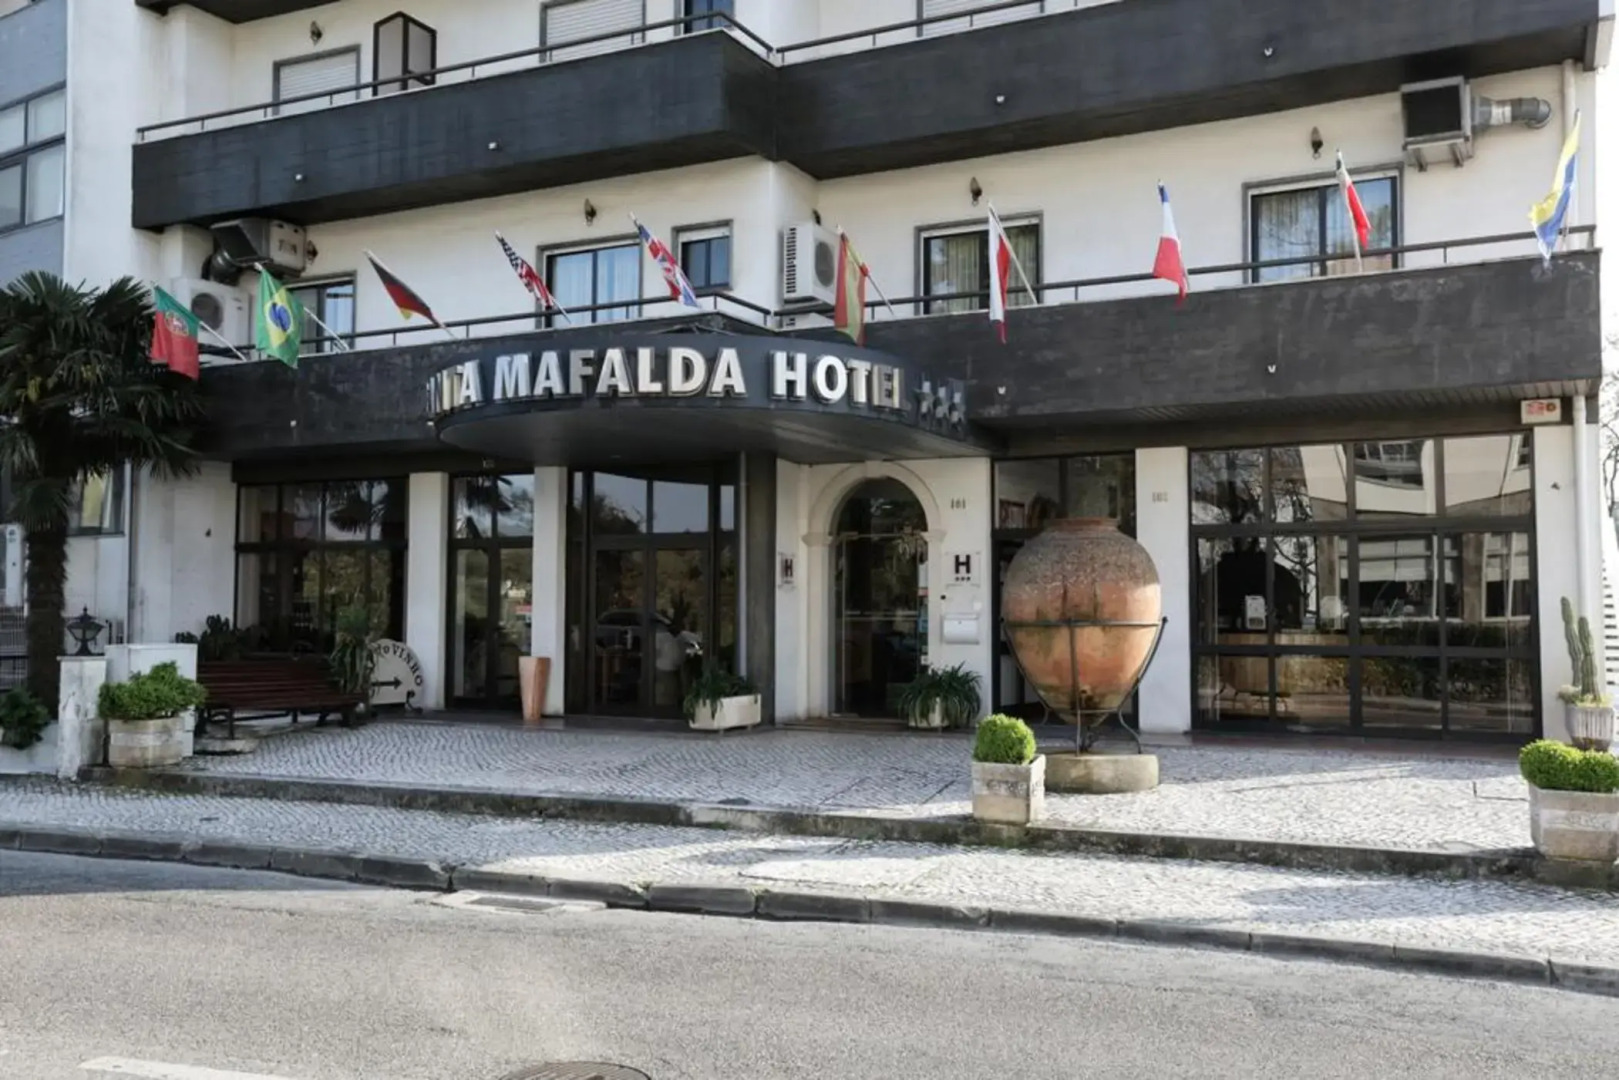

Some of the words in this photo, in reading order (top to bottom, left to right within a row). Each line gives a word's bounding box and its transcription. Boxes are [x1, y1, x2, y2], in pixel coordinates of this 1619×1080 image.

[492, 347, 748, 400] MAFALDA
[771, 350, 907, 409] HOTEL
[784, 558, 793, 577] H
[954, 554, 971, 574] H
